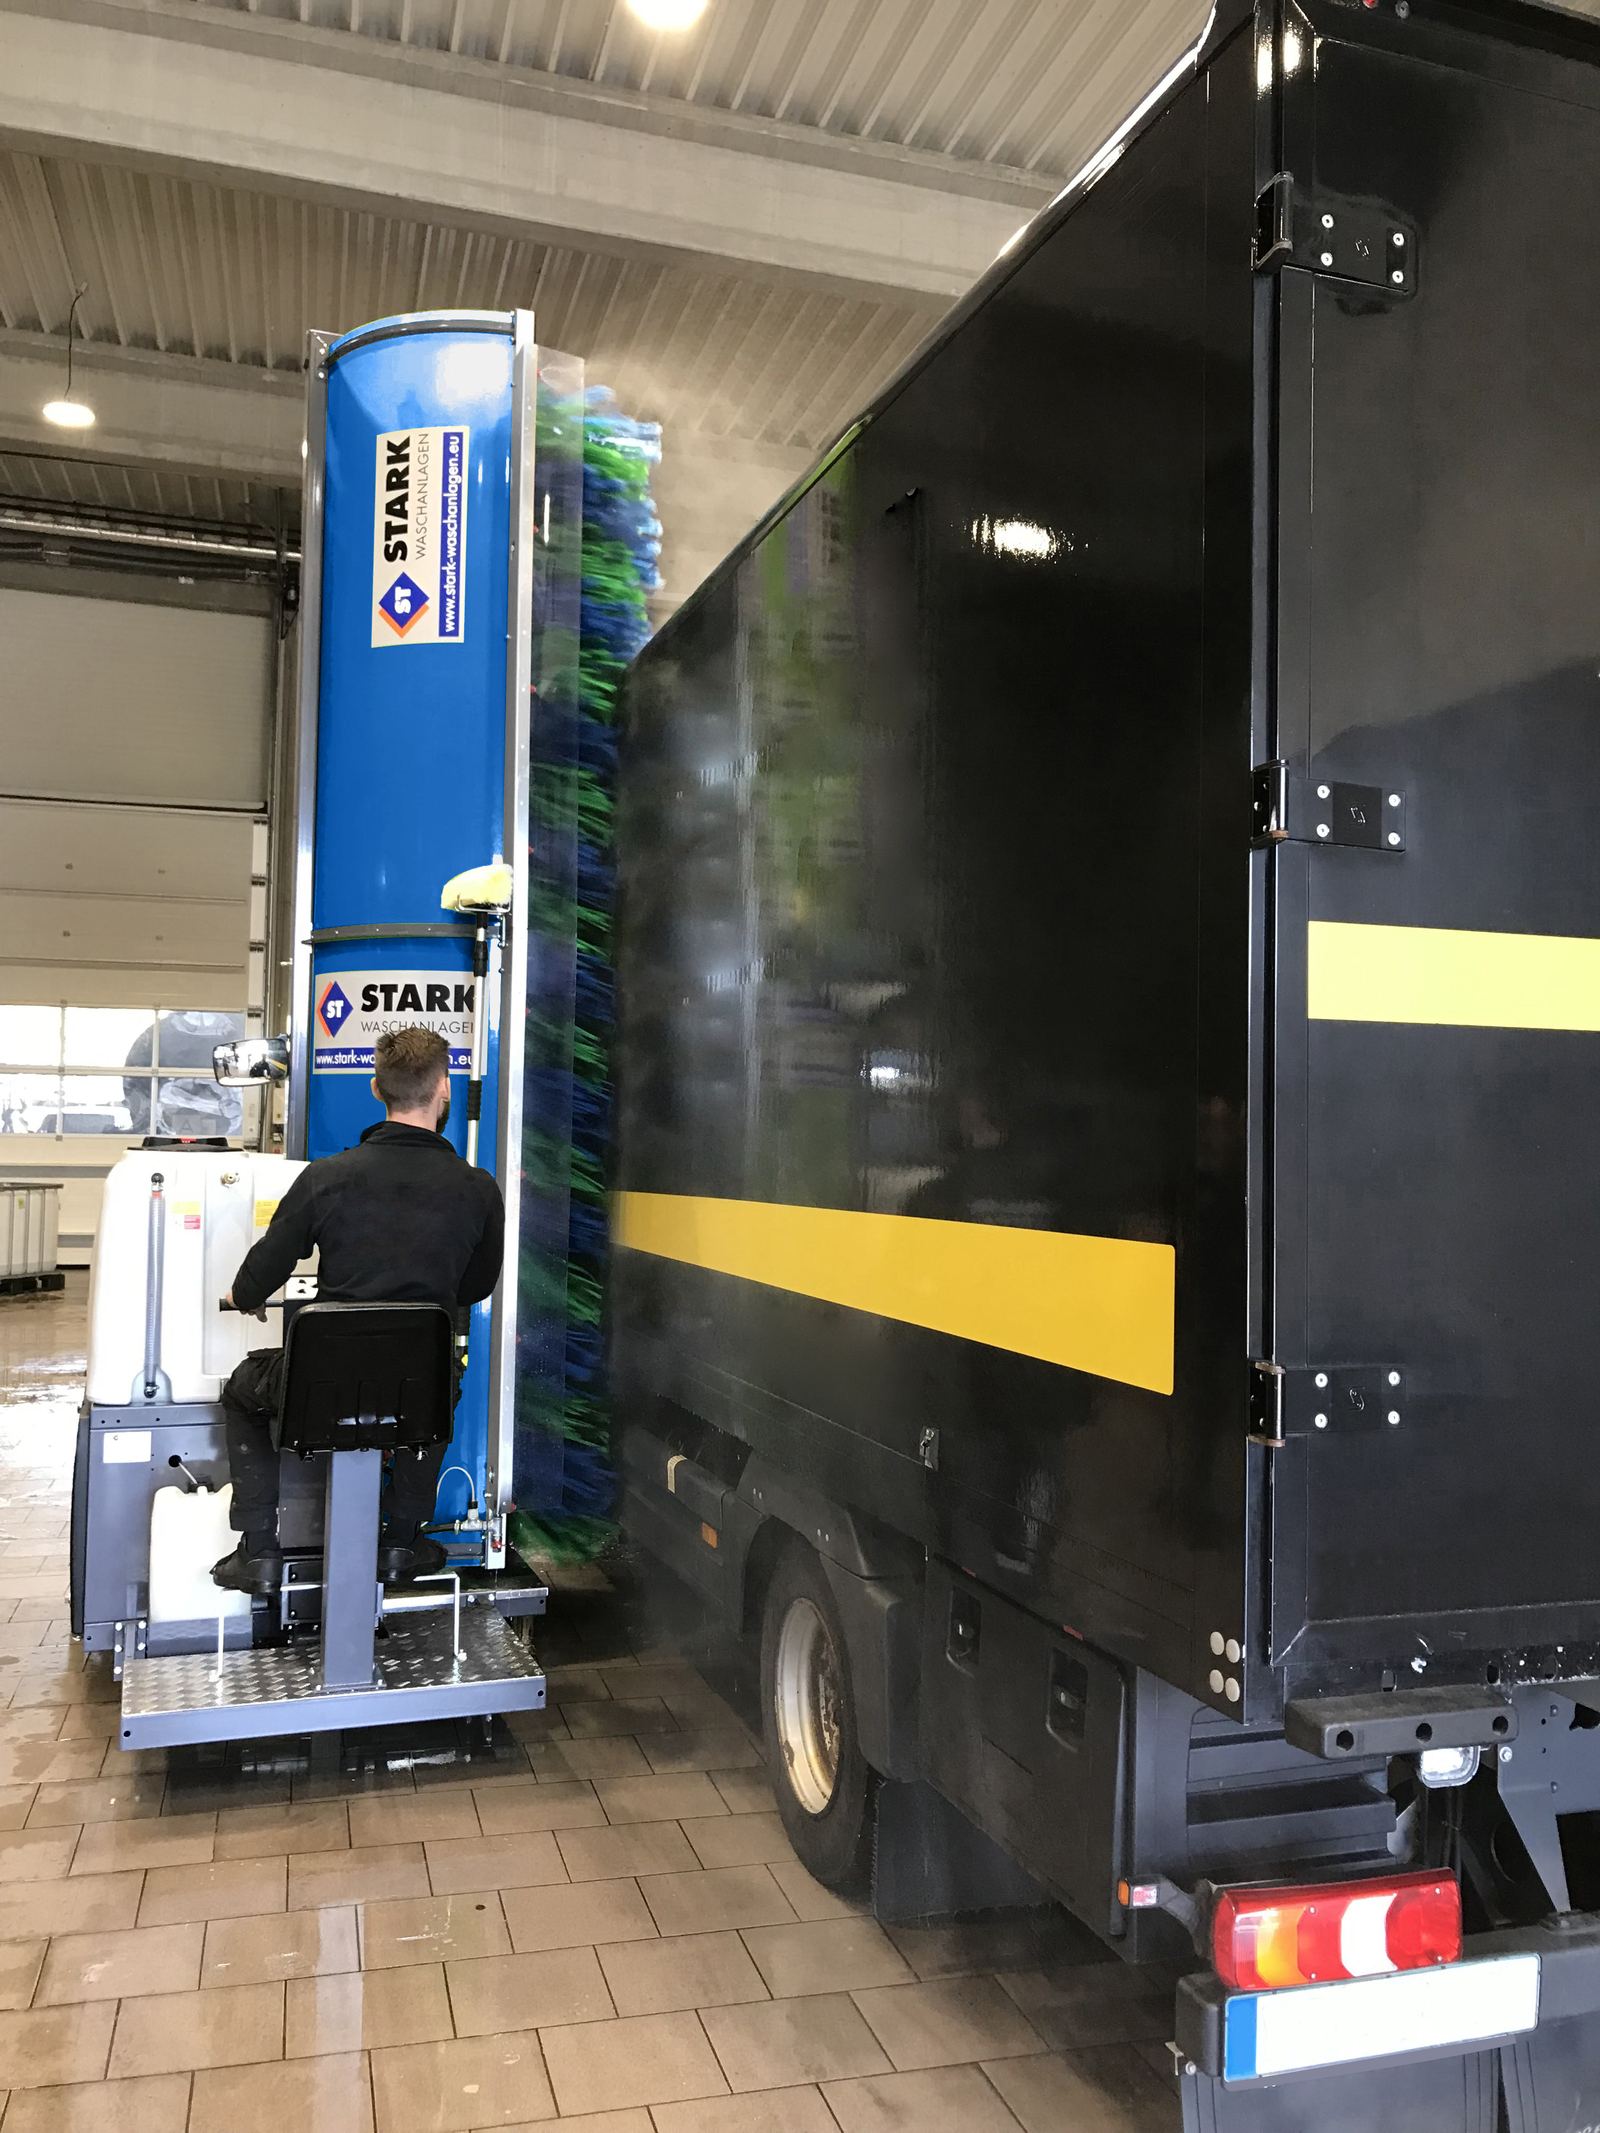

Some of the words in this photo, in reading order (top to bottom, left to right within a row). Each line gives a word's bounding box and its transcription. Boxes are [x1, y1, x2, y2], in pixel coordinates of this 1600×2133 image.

[384, 435, 411, 563] STARK
[415, 433, 429, 560] WASCHANLAGEN
[441, 436, 462, 633] www.stark-waschanlagen.eu
[394, 586, 412, 615] ST
[326, 1000, 344, 1019] ST
[360, 983, 475, 1013] STARK
[361, 1020, 474, 1034] WASCHANLAGE
